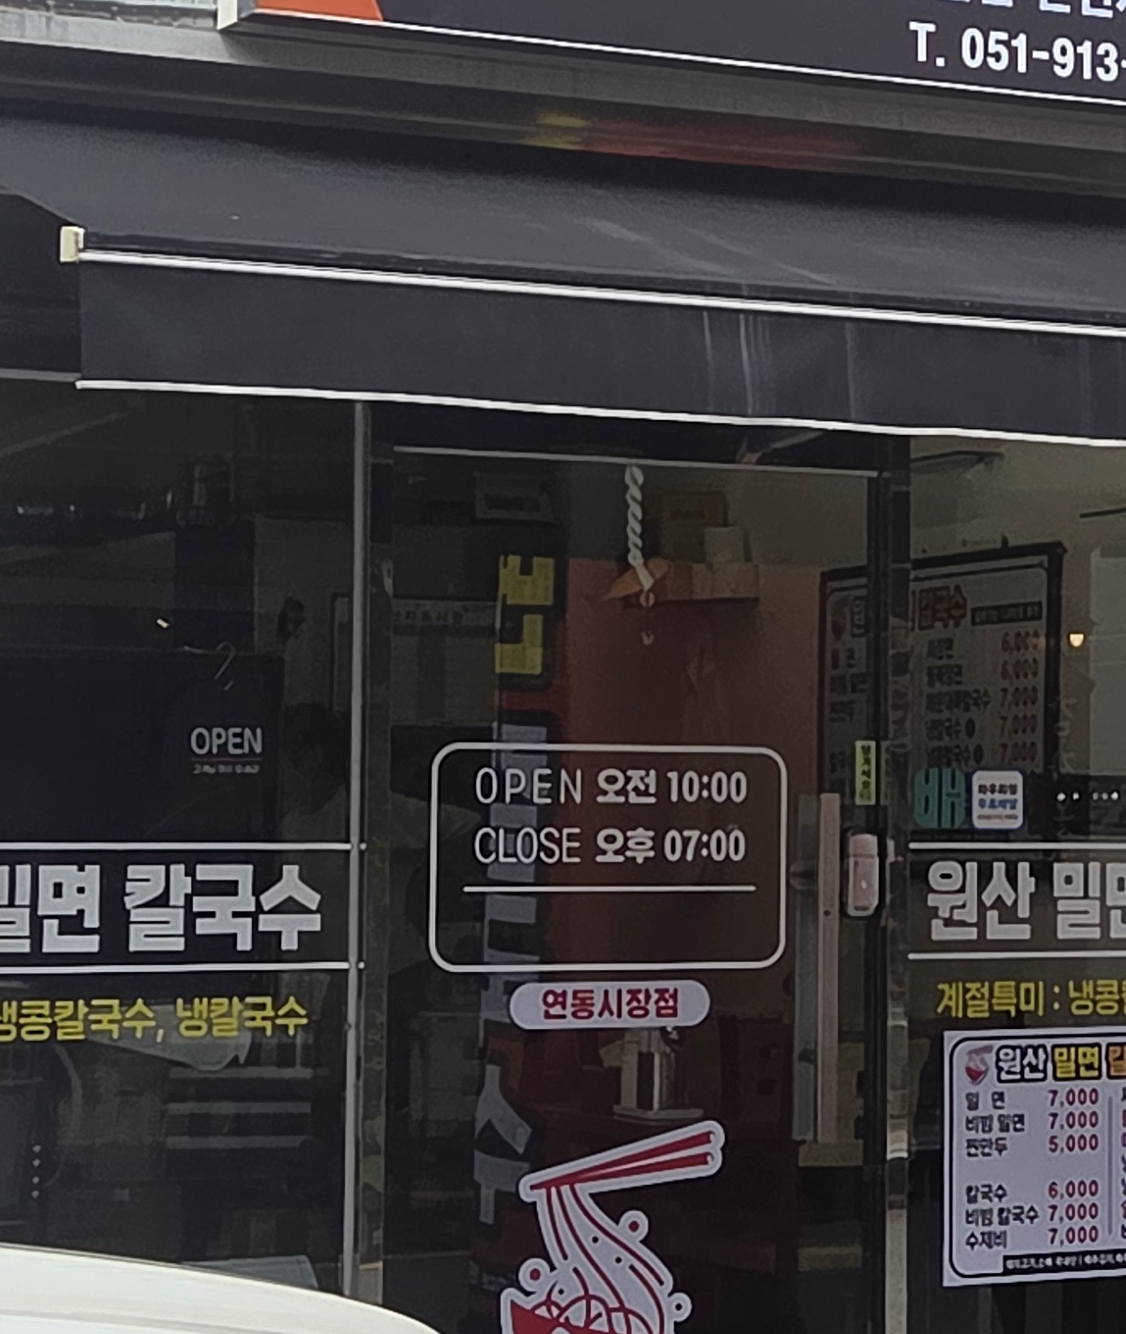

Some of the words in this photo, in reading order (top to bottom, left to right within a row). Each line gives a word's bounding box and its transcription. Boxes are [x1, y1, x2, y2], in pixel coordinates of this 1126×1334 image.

[908, 21, 946, 70] T.
[190, 727, 262, 755] OPEN
[475, 768, 584, 806] OPEN
[597, 768, 657, 805] 오전
[667, 770, 748, 804] 10:00
[474, 828, 581, 865] CLOSE
[596, 828, 655, 865] 오후
[663, 828, 746, 863] 07:00
[124, 863, 322, 952] 칼국수
[927, 861, 1036, 941] 원산
[542, 988, 680, 1020] 연동시장점
[937, 981, 1045, 1018] 계절특미
[176, 996, 309, 1038] 냉칼국수
[998, 1047, 1047, 1081] 원산
[1053, 1046, 1099, 1078] 밀면
[1048, 1088, 1099, 1107] 7,000
[1048, 1111, 1099, 1130] 7,000
[1048, 1133, 1099, 1154] 5,000
[965, 1184, 1008, 1204] 칼국수
[1048, 1179, 1099, 1199] 6,000
[997, 1205, 1039, 1225] 칼국수
[1048, 1202, 1099, 1223] 7,000
[965, 1230, 1007, 1251] 수제비
[1048, 1225, 1099, 1246] 7,000
